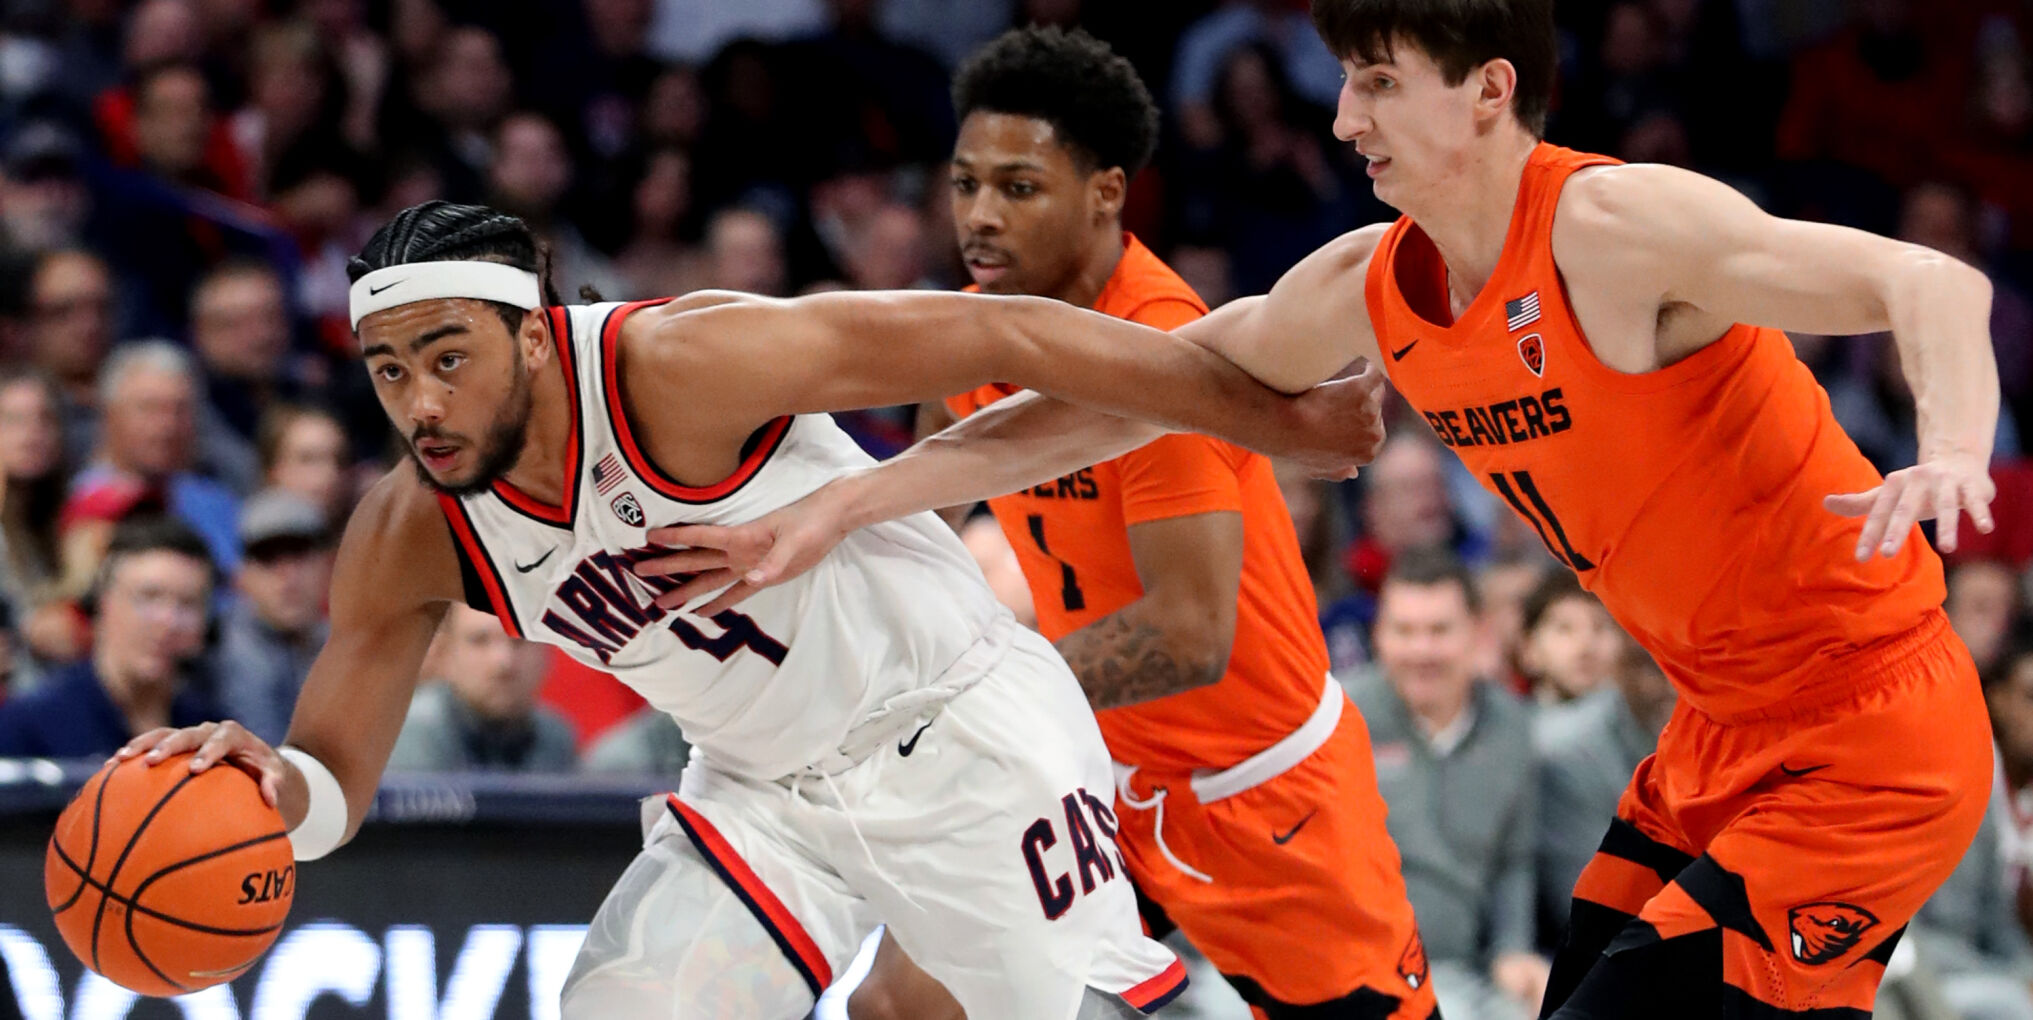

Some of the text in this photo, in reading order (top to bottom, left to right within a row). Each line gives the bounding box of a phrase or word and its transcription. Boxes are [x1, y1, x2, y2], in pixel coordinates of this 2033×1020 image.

[1423, 387, 1572, 447] BEAVERS
[1489, 470, 1596, 572] 11
[1027, 514, 1086, 612] 1
[668, 608, 789, 667] 4
[238, 865, 294, 905] CATS
